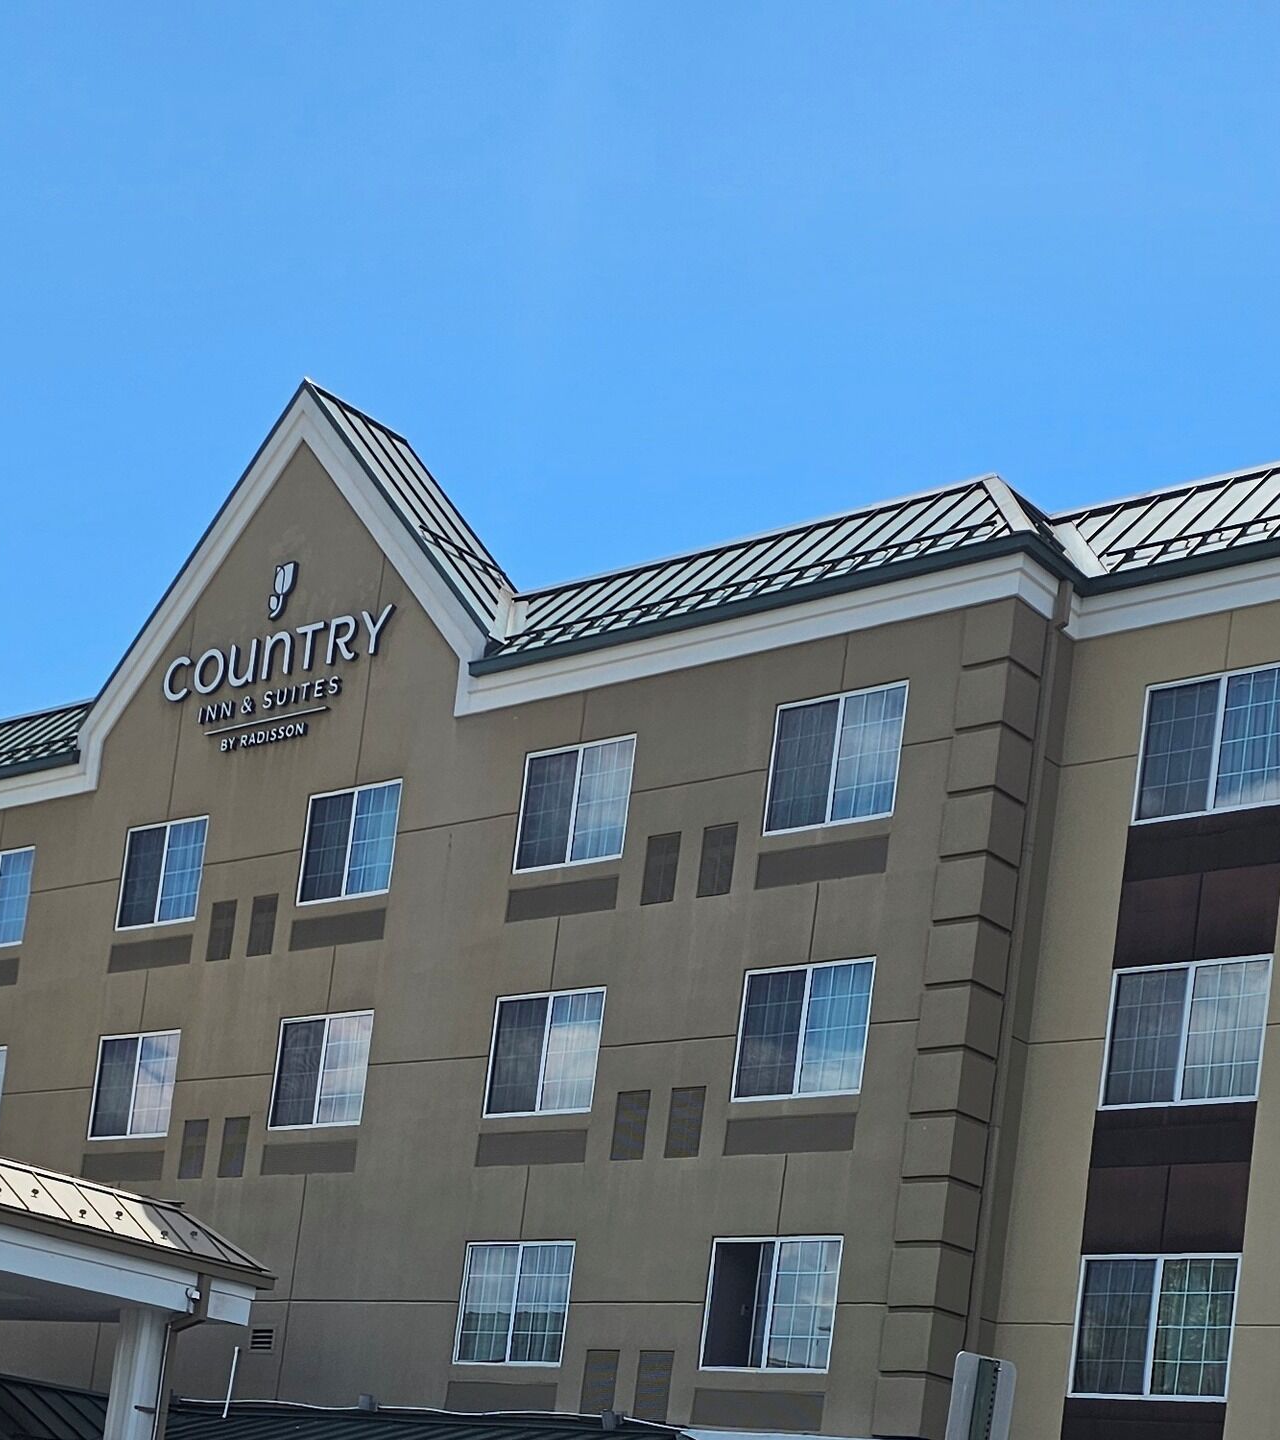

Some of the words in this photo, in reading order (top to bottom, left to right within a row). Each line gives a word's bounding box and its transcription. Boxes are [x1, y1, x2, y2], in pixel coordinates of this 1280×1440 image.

[197, 700, 235, 724] INN
[240, 695, 254, 715] &
[262, 676, 342, 709] SUITES
[220, 738, 238, 752] BY
[240, 722, 308, 748] RADISSON
